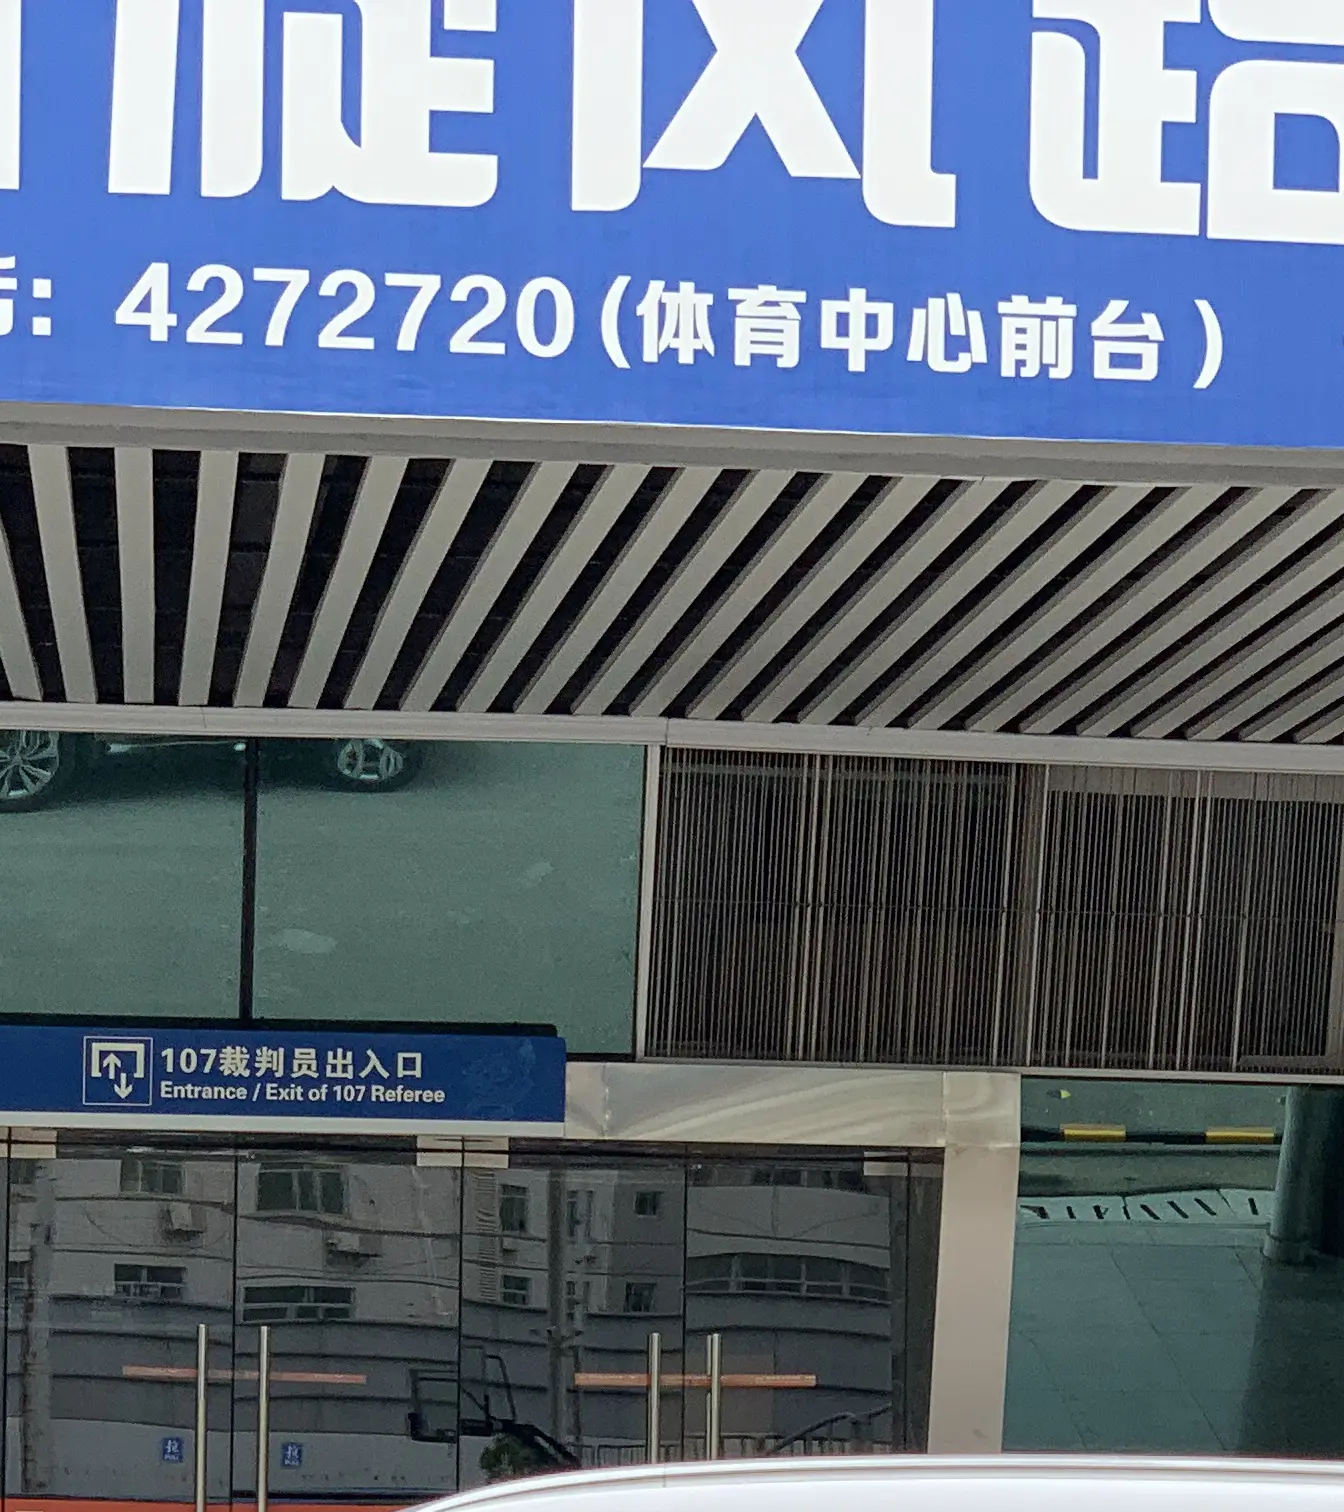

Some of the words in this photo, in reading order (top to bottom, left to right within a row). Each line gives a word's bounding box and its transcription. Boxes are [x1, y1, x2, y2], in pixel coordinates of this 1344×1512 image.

[160, 1045, 423, 1079] 107裁判员出入口
[160, 1081, 248, 1100] Entrance
[265, 1083, 304, 1101] Exit
[308, 1084, 328, 1101] of
[333, 1085, 366, 1102] 107
[371, 1084, 446, 1103] Referee
